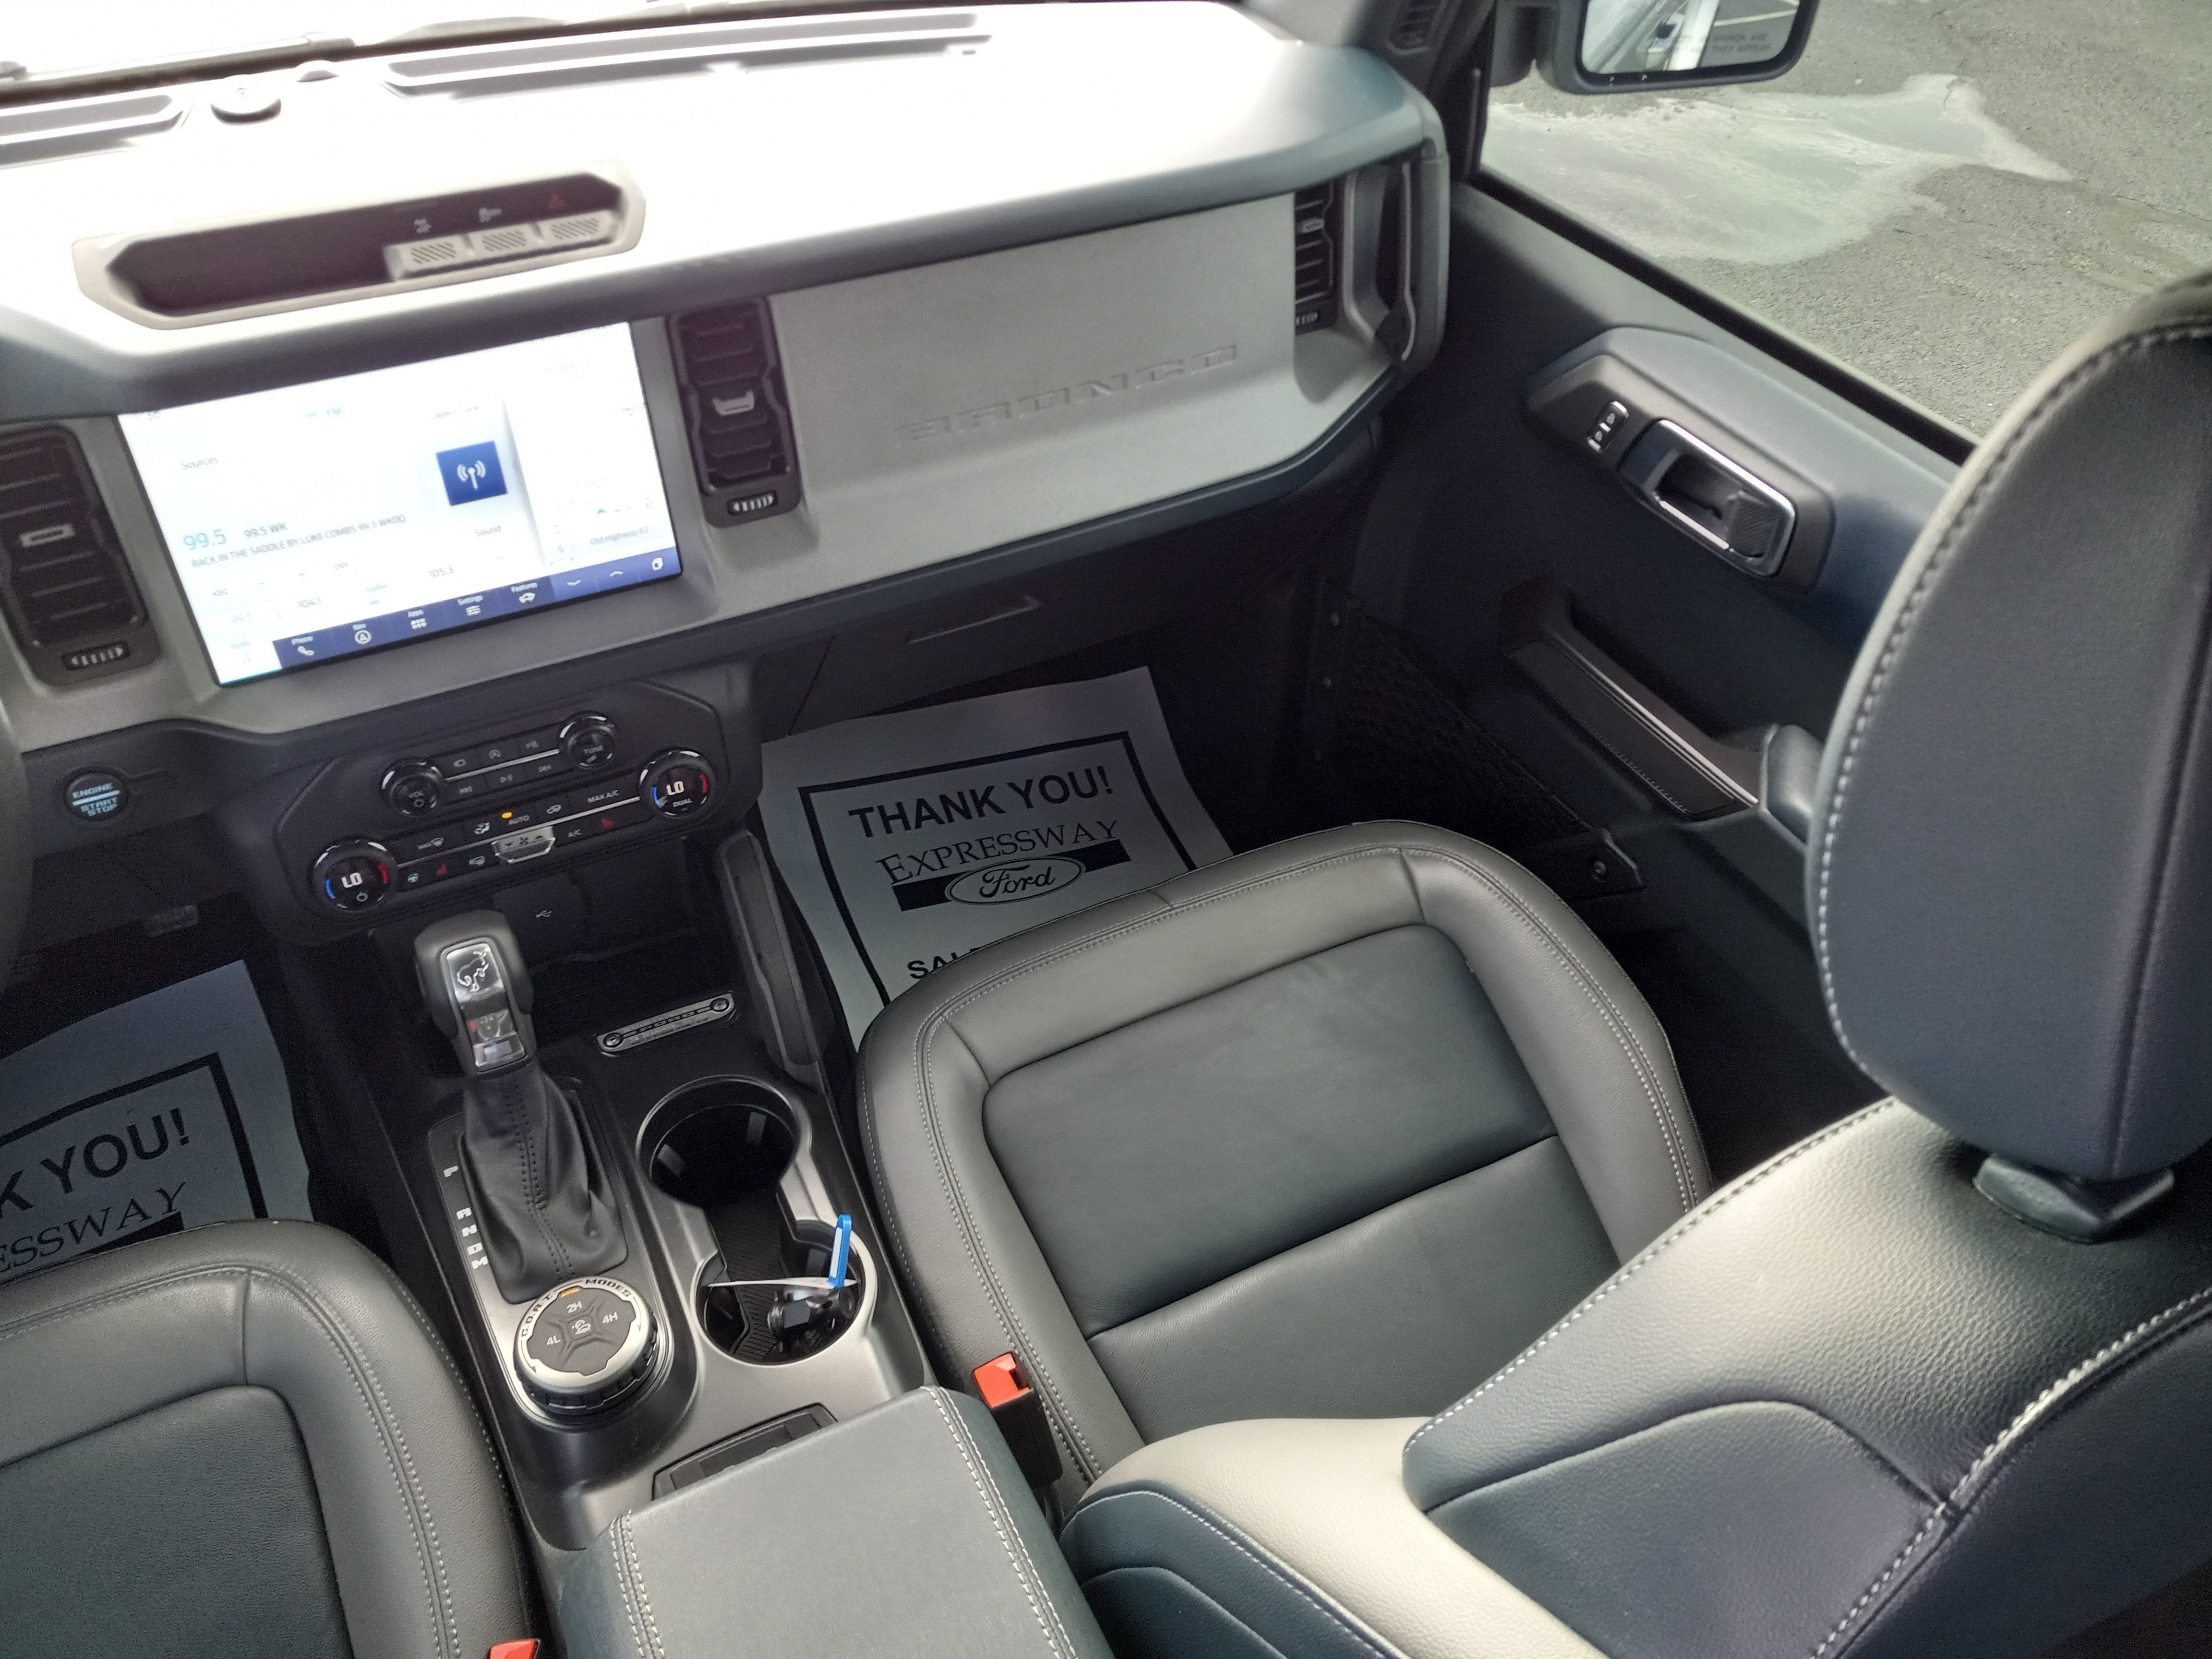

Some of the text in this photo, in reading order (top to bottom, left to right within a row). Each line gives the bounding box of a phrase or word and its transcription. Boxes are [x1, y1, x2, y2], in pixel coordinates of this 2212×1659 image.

[895, 344, 1237, 449] BRONCO
[475, 525, 502, 537] Sound
[605, 531, 637, 543] Highway
[183, 529, 226, 550] 99.5
[243, 526, 267, 539] 99.5
[192, 555, 217, 567] BACK
[218, 553, 229, 562] IN
[230, 549, 248, 558] THE
[287, 538, 299, 547] BY
[301, 532, 324, 544] LUKE
[429, 566, 454, 577] 105.3
[510, 581, 538, 593] Features
[72, 783, 113, 799] ENGINE
[666, 781, 685, 795] LO
[81, 797, 117, 812] START
[588, 794, 605, 803] MAX
[673, 798, 693, 807] DUAL
[848, 766, 1114, 838] THANK YOU!
[88, 804, 117, 816] STOP
[508, 816, 529, 825] AUTO
[876, 820, 1118, 885] EXPRESSWAY
[341, 872, 362, 888] LO
[979, 865, 1056, 898] Ford
[40, 1108, 190, 1194] YOU!
[462, 1224, 477, 1237] N
[471, 1256, 489, 1269] M
[585, 1279, 632, 1298] MODES
[566, 1301, 583, 1314] 2H
[602, 1312, 618, 1324] 4H
[546, 1335, 561, 1346] 4L
